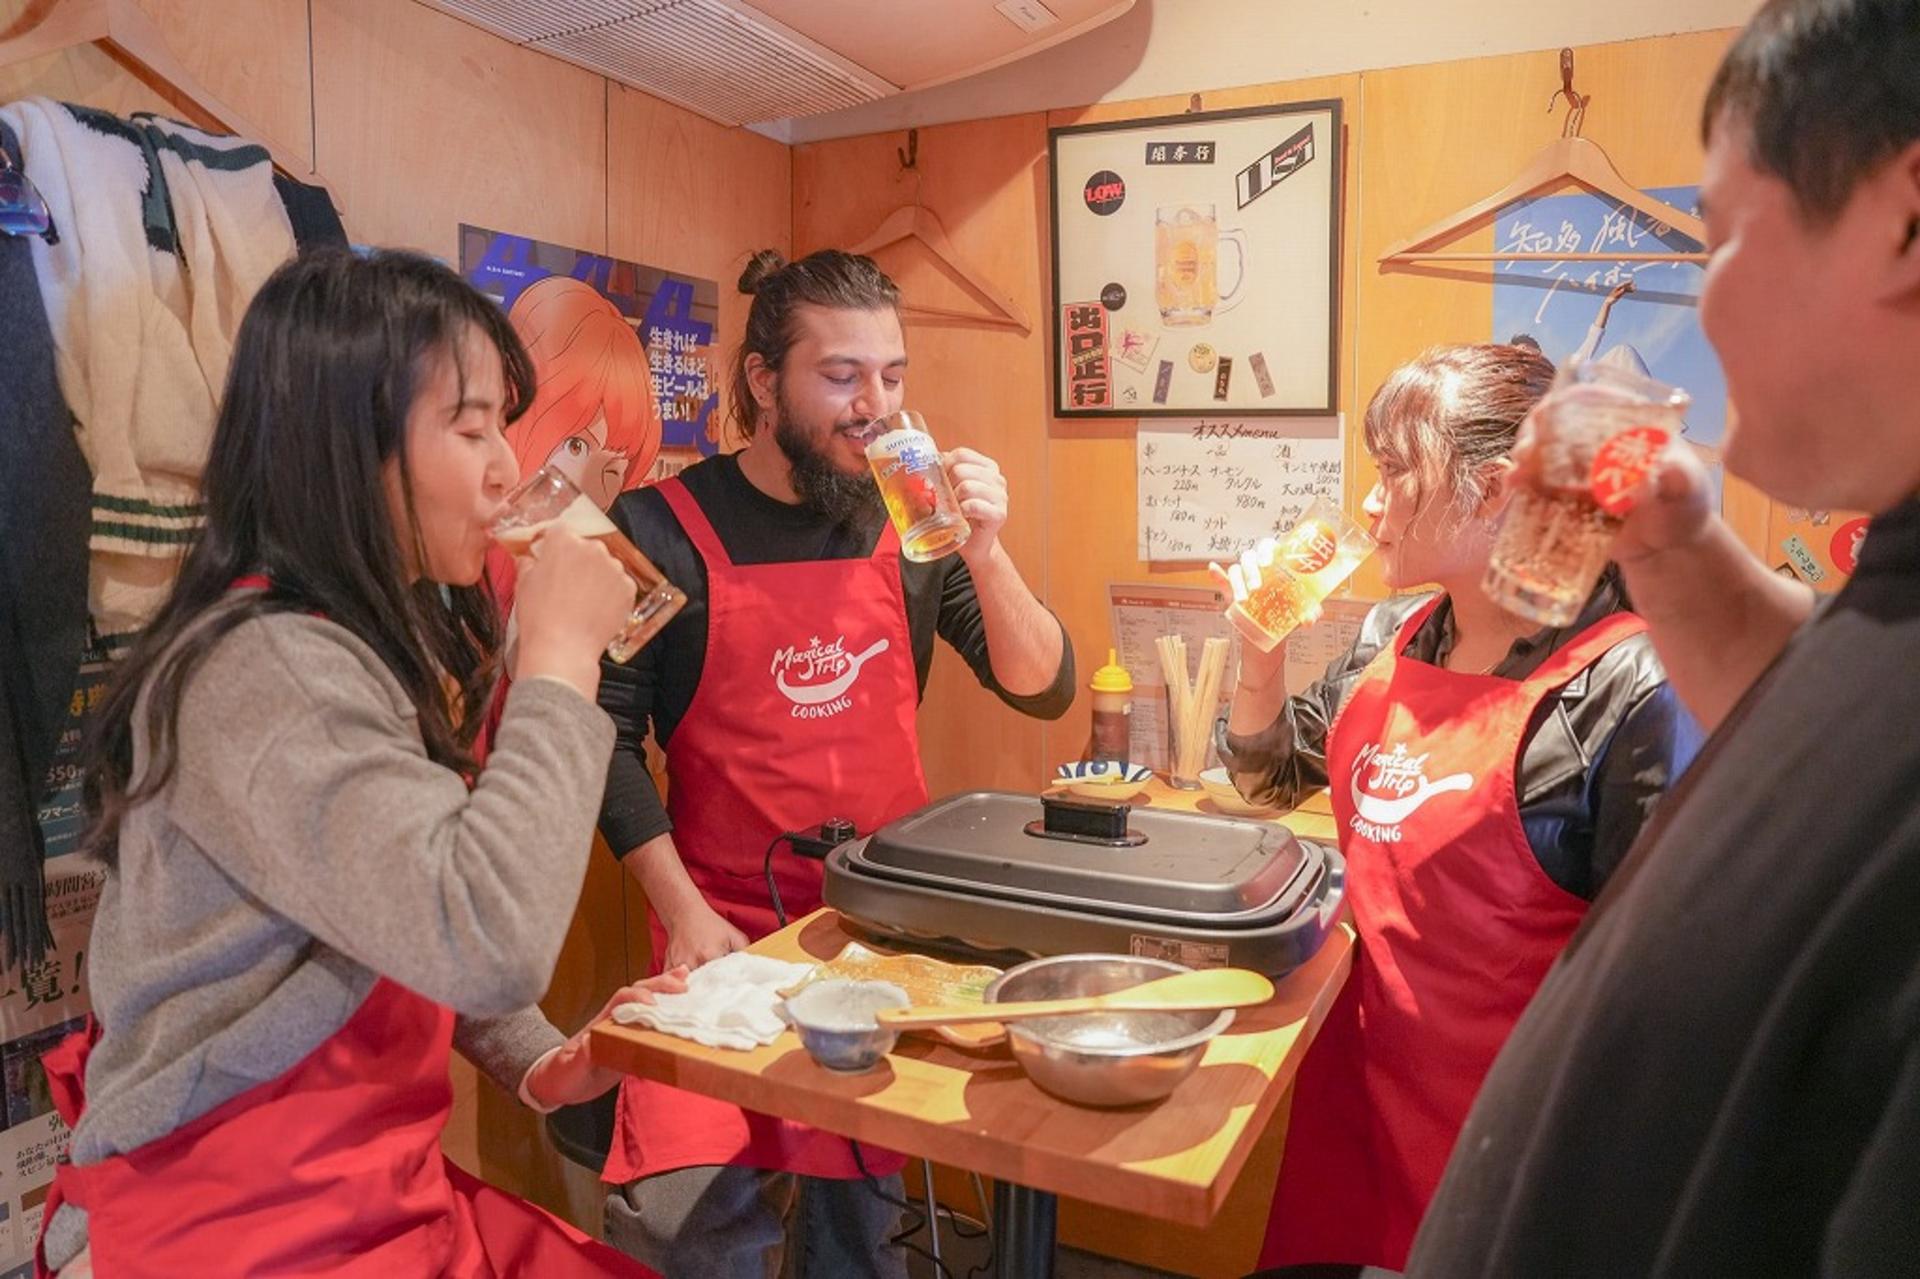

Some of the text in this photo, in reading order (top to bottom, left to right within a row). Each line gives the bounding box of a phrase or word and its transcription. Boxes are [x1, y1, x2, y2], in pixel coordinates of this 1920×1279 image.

[650, 326, 698, 353] 生きれば
[650, 350, 707, 378] 生きるほど
[650, 375, 710, 400] 生ビールは
[770, 635, 845, 680] Magical
[815, 653, 846, 677] Trip
[791, 696, 852, 718] COOKING
[1349, 813, 1402, 843] COOKING
